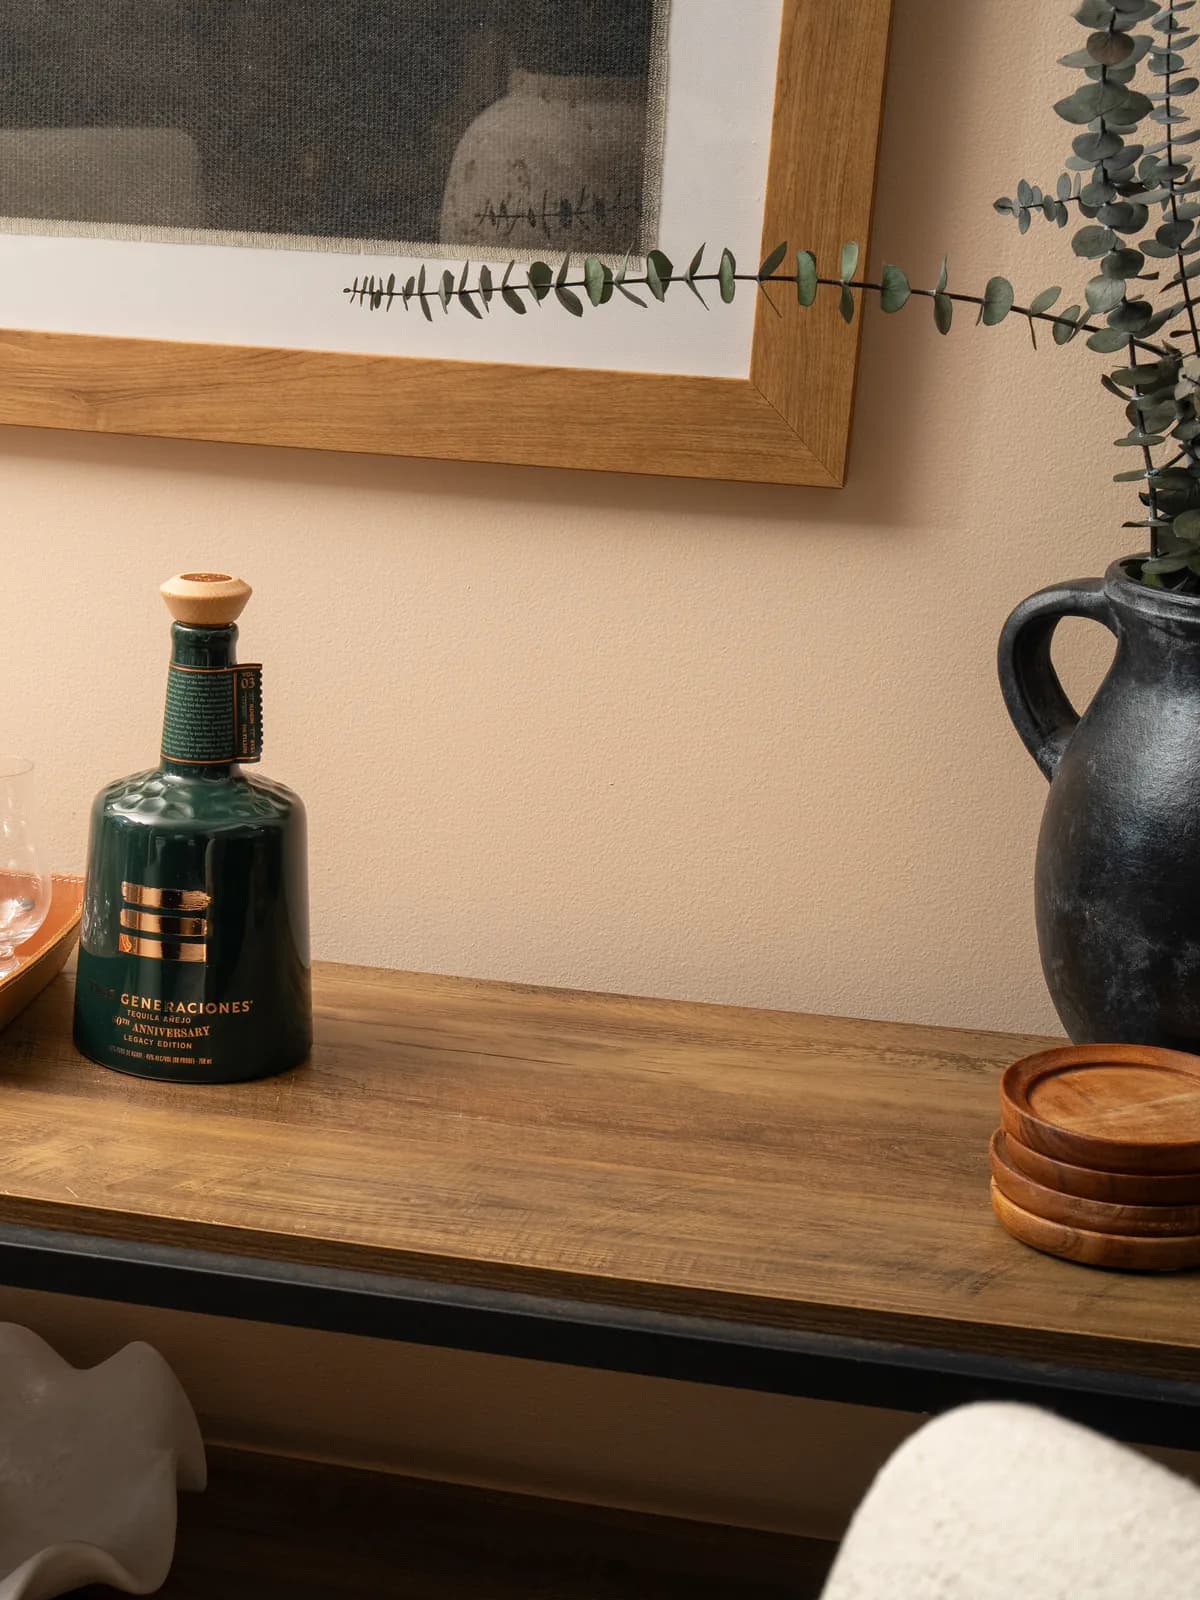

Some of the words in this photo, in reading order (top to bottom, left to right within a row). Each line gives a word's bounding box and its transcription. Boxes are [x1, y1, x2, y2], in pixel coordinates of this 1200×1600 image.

[241, 677, 256, 689] 03
[120, 993, 250, 1014] GENERACIONES
[127, 1010, 160, 1022] TEQUILA
[163, 1015, 192, 1024] AÑEJO
[132, 1022, 211, 1039] ANNIVERSARY
[123, 1034, 154, 1046] LEGACY
[157, 1040, 193, 1050] EDITION
